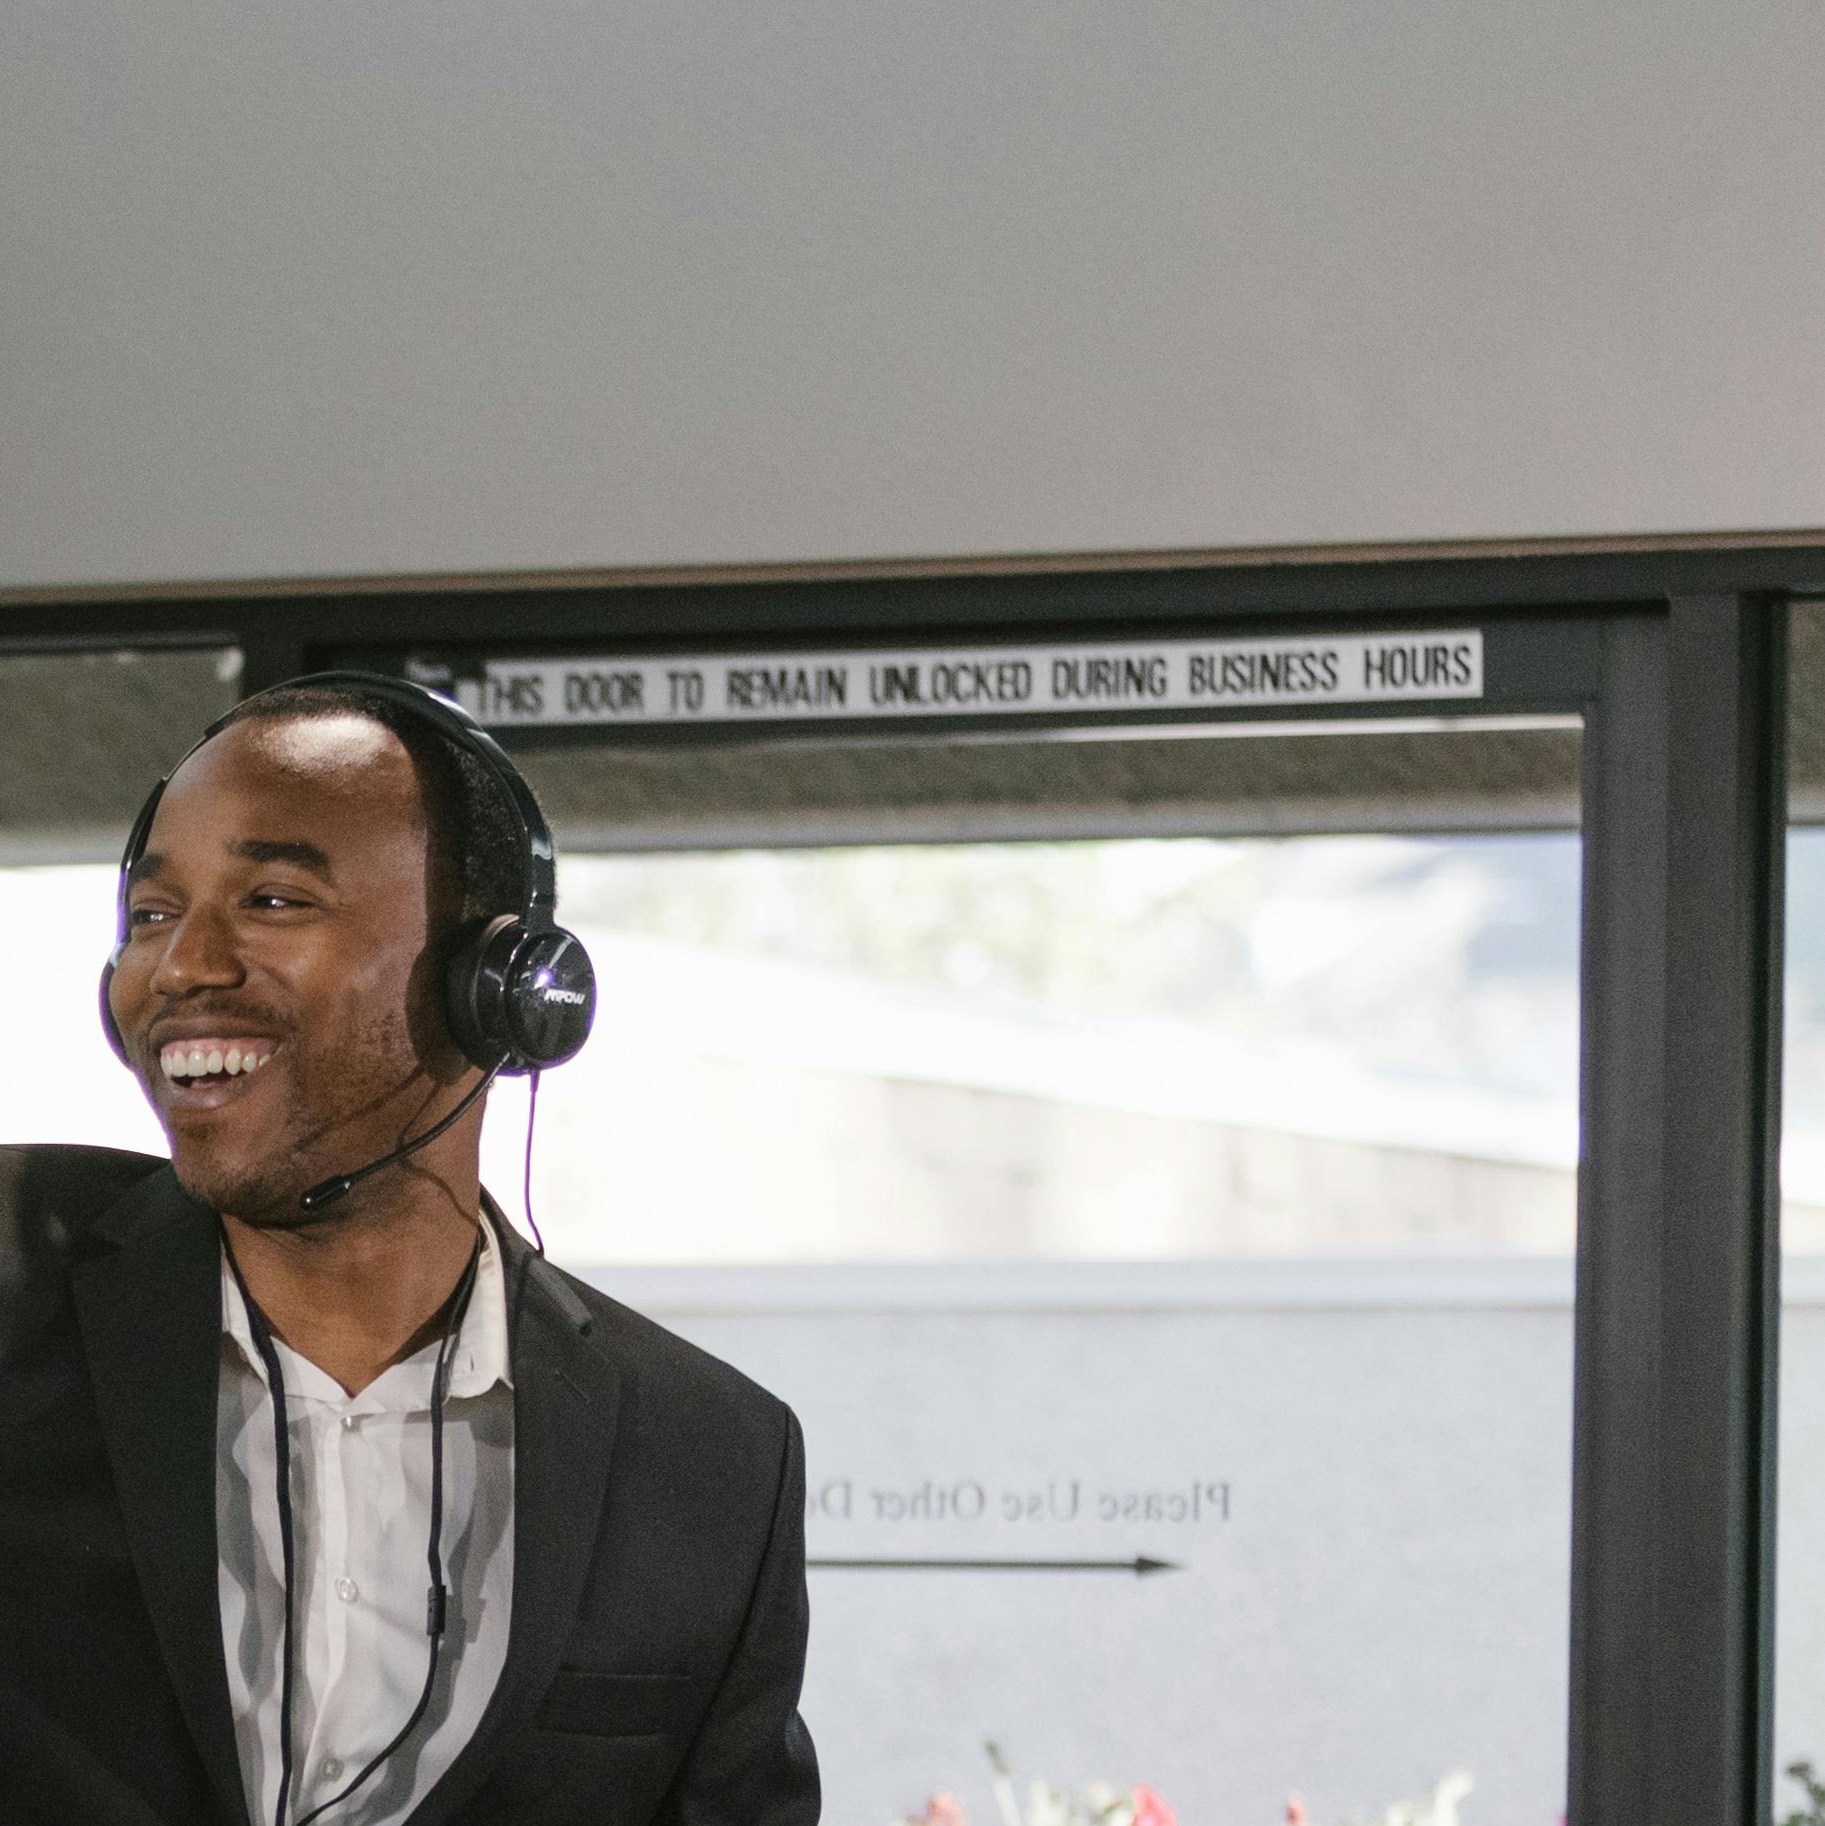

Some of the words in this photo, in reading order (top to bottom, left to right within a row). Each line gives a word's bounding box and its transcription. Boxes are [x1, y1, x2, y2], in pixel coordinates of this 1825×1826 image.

[475, 670, 544, 717] THIS
[565, 670, 645, 716] DOOR
[666, 670, 705, 715] TO
[726, 663, 847, 710] REMAIN
[869, 660, 1032, 709] UNLOCKED
[1052, 656, 1168, 700] DURING
[1188, 651, 1338, 695] BUSINESS
[1364, 645, 1472, 689] HOURS
